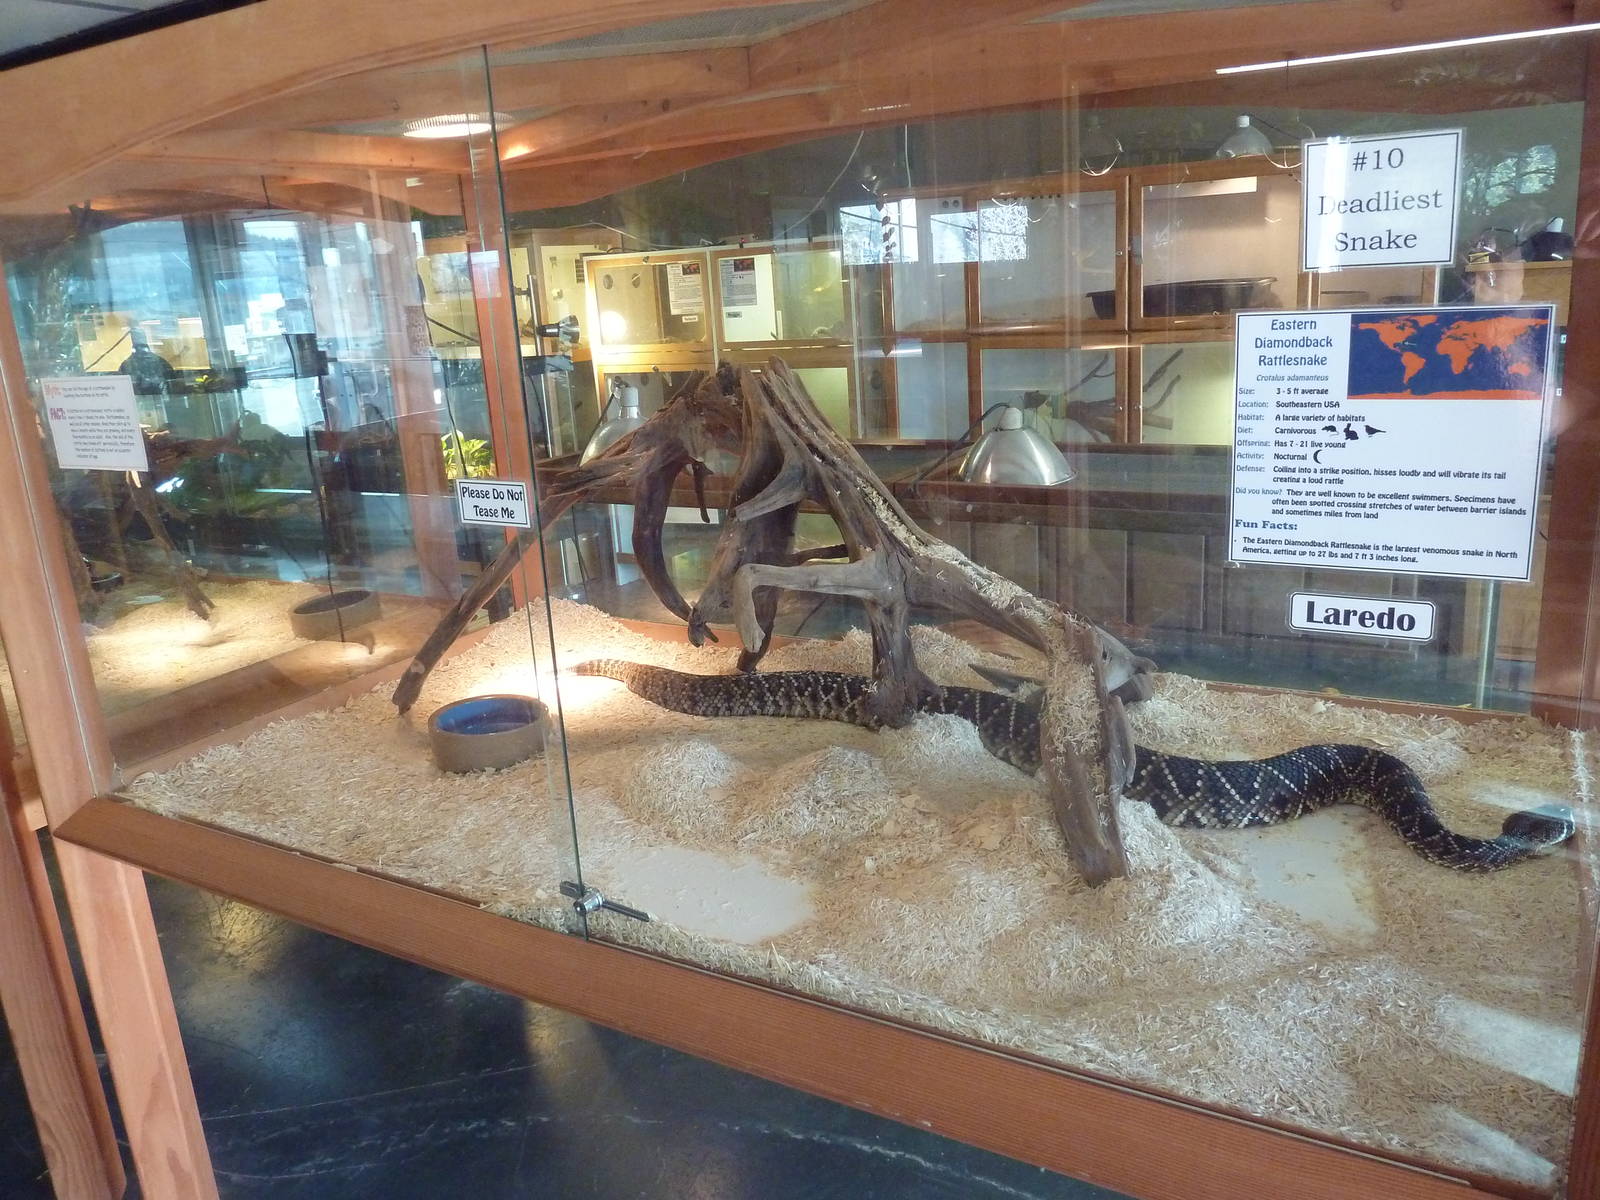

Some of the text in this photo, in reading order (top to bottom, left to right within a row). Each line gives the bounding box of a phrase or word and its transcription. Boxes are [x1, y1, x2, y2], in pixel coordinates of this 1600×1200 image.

[1353, 147, 1404, 171] #10
[1318, 189, 1443, 216] Deadliest
[1335, 229, 1418, 252] Snake
[1271, 319, 1317, 331] Eastern
[1254, 336, 1333, 348] Diamondback
[1258, 354, 1328, 366] Rattlesnake
[1256, 374, 1329, 382] Crotalus adamanteus
[1238, 387, 1256, 395] Size:
[1276, 387, 1281, 395] 3
[1287, 387, 1292, 395] 5
[1293, 387, 1300, 395] ft
[1238, 400, 1269, 408] Location:
[1282, 414, 1300, 422] large
[1302, 414, 1326, 422] variety
[1328, 414, 1336, 422] of
[1337, 414, 1366, 422] habitats
[1237, 426, 1317, 434] Diet: Carnivorous
[1274, 440, 1288, 448] Has
[1289, 440, 1294, 448] 7
[1310, 440, 1323, 448] live
[1237, 452, 1265, 460] Activity:
[1298, 466, 1312, 474] into
[1374, 468, 1397, 476] hisses
[1399, 469, 1421, 477] loudly
[1453, 471, 1480, 479] vibrate
[1324, 477, 1344, 485] rattle
[462, 486, 523, 501] Please Do Not
[1333, 490, 1356, 498] known
[1377, 492, 1410, 500] excellent
[1454, 495, 1496, 504] Specimens
[1497, 496, 1516, 504] have
[473, 505, 515, 519] Tease Me
[1309, 499, 1335, 507] spotted
[1369, 502, 1403, 510] stretches
[1404, 502, 1412, 510] of
[1437, 504, 1468, 512] between
[1470, 505, 1498, 514] barrier
[1499, 507, 1527, 515] islands
[1285, 509, 1322, 517] sometimes
[1324, 510, 1343, 518] miles
[1364, 511, 1379, 519] land
[1235, 519, 1298, 531] Fun Facts:
[1243, 536, 1518, 559] The Eastern Diamondback Rattlesnake is the largest venomous snake in North
[1273, 548, 1297, 556] getting
[1318, 550, 1326, 558] 27
[1376, 554, 1399, 562] inches
[1400, 555, 1419, 563] long.
[1306, 601, 1416, 632] Laredo
